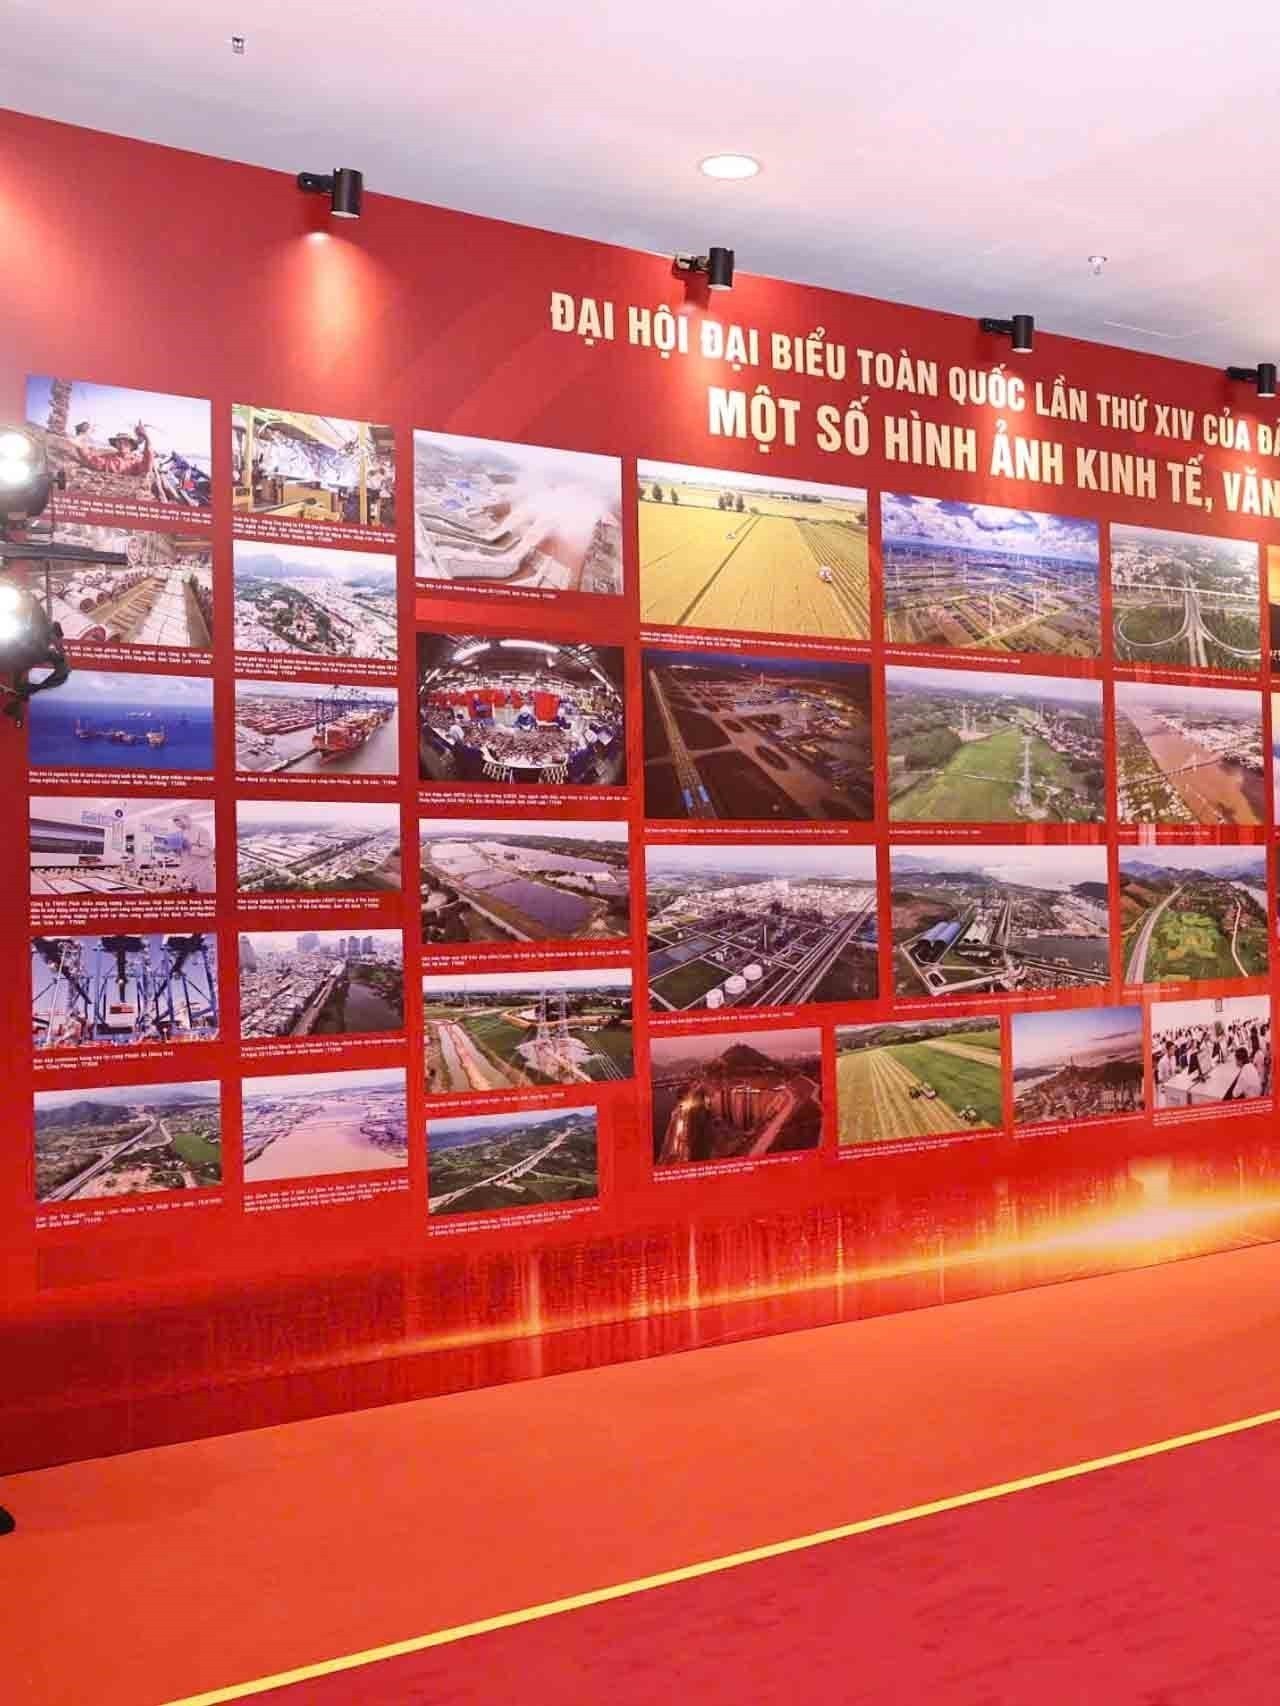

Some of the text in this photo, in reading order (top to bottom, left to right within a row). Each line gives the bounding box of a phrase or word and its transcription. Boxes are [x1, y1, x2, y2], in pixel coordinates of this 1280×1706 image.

[550, 291, 614, 346] ĐẠI
[628, 303, 688, 360] HỘI
[701, 319, 759, 372] ĐẠI
[771, 326, 846, 381] BIỂU
[857, 342, 938, 396] TOÀN
[949, 362, 1025, 412] QUỐC
[1035, 375, 1089, 422] LẦN
[1096, 392, 1149, 432] THỨ
[1154, 403, 1194, 441] XIV
[1203, 404, 1253, 454] CỦA
[708, 384, 801, 453] MỘT
[816, 393, 869, 457] SỐ
[884, 410, 977, 473] HÌNH
[989, 420, 1064, 486] ẢNH
[1076, 446, 1156, 498] KINH
[1167, 454, 1213, 513] TẾ,
